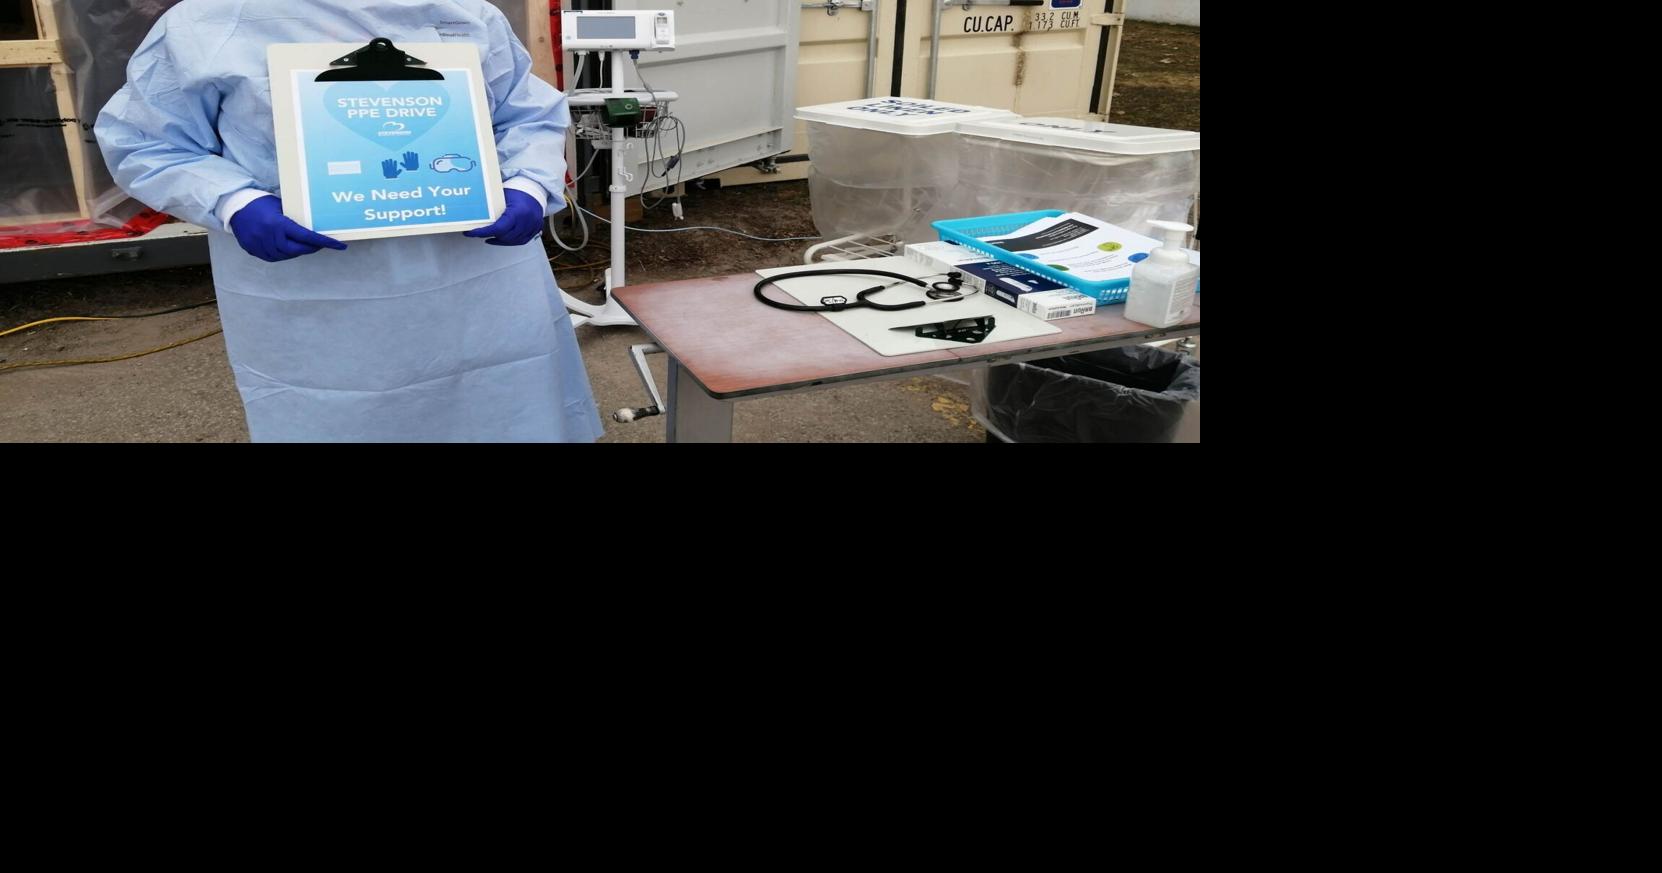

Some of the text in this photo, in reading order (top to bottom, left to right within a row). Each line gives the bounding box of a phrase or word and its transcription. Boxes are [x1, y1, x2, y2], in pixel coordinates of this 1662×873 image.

[963, 15, 1014, 33] CU.CAP.
[337, 96, 443, 108] STEVENSON
[347, 107, 437, 119] PPE DRIVE
[331, 186, 471, 203] We Need Your
[364, 204, 446, 222] Support!
